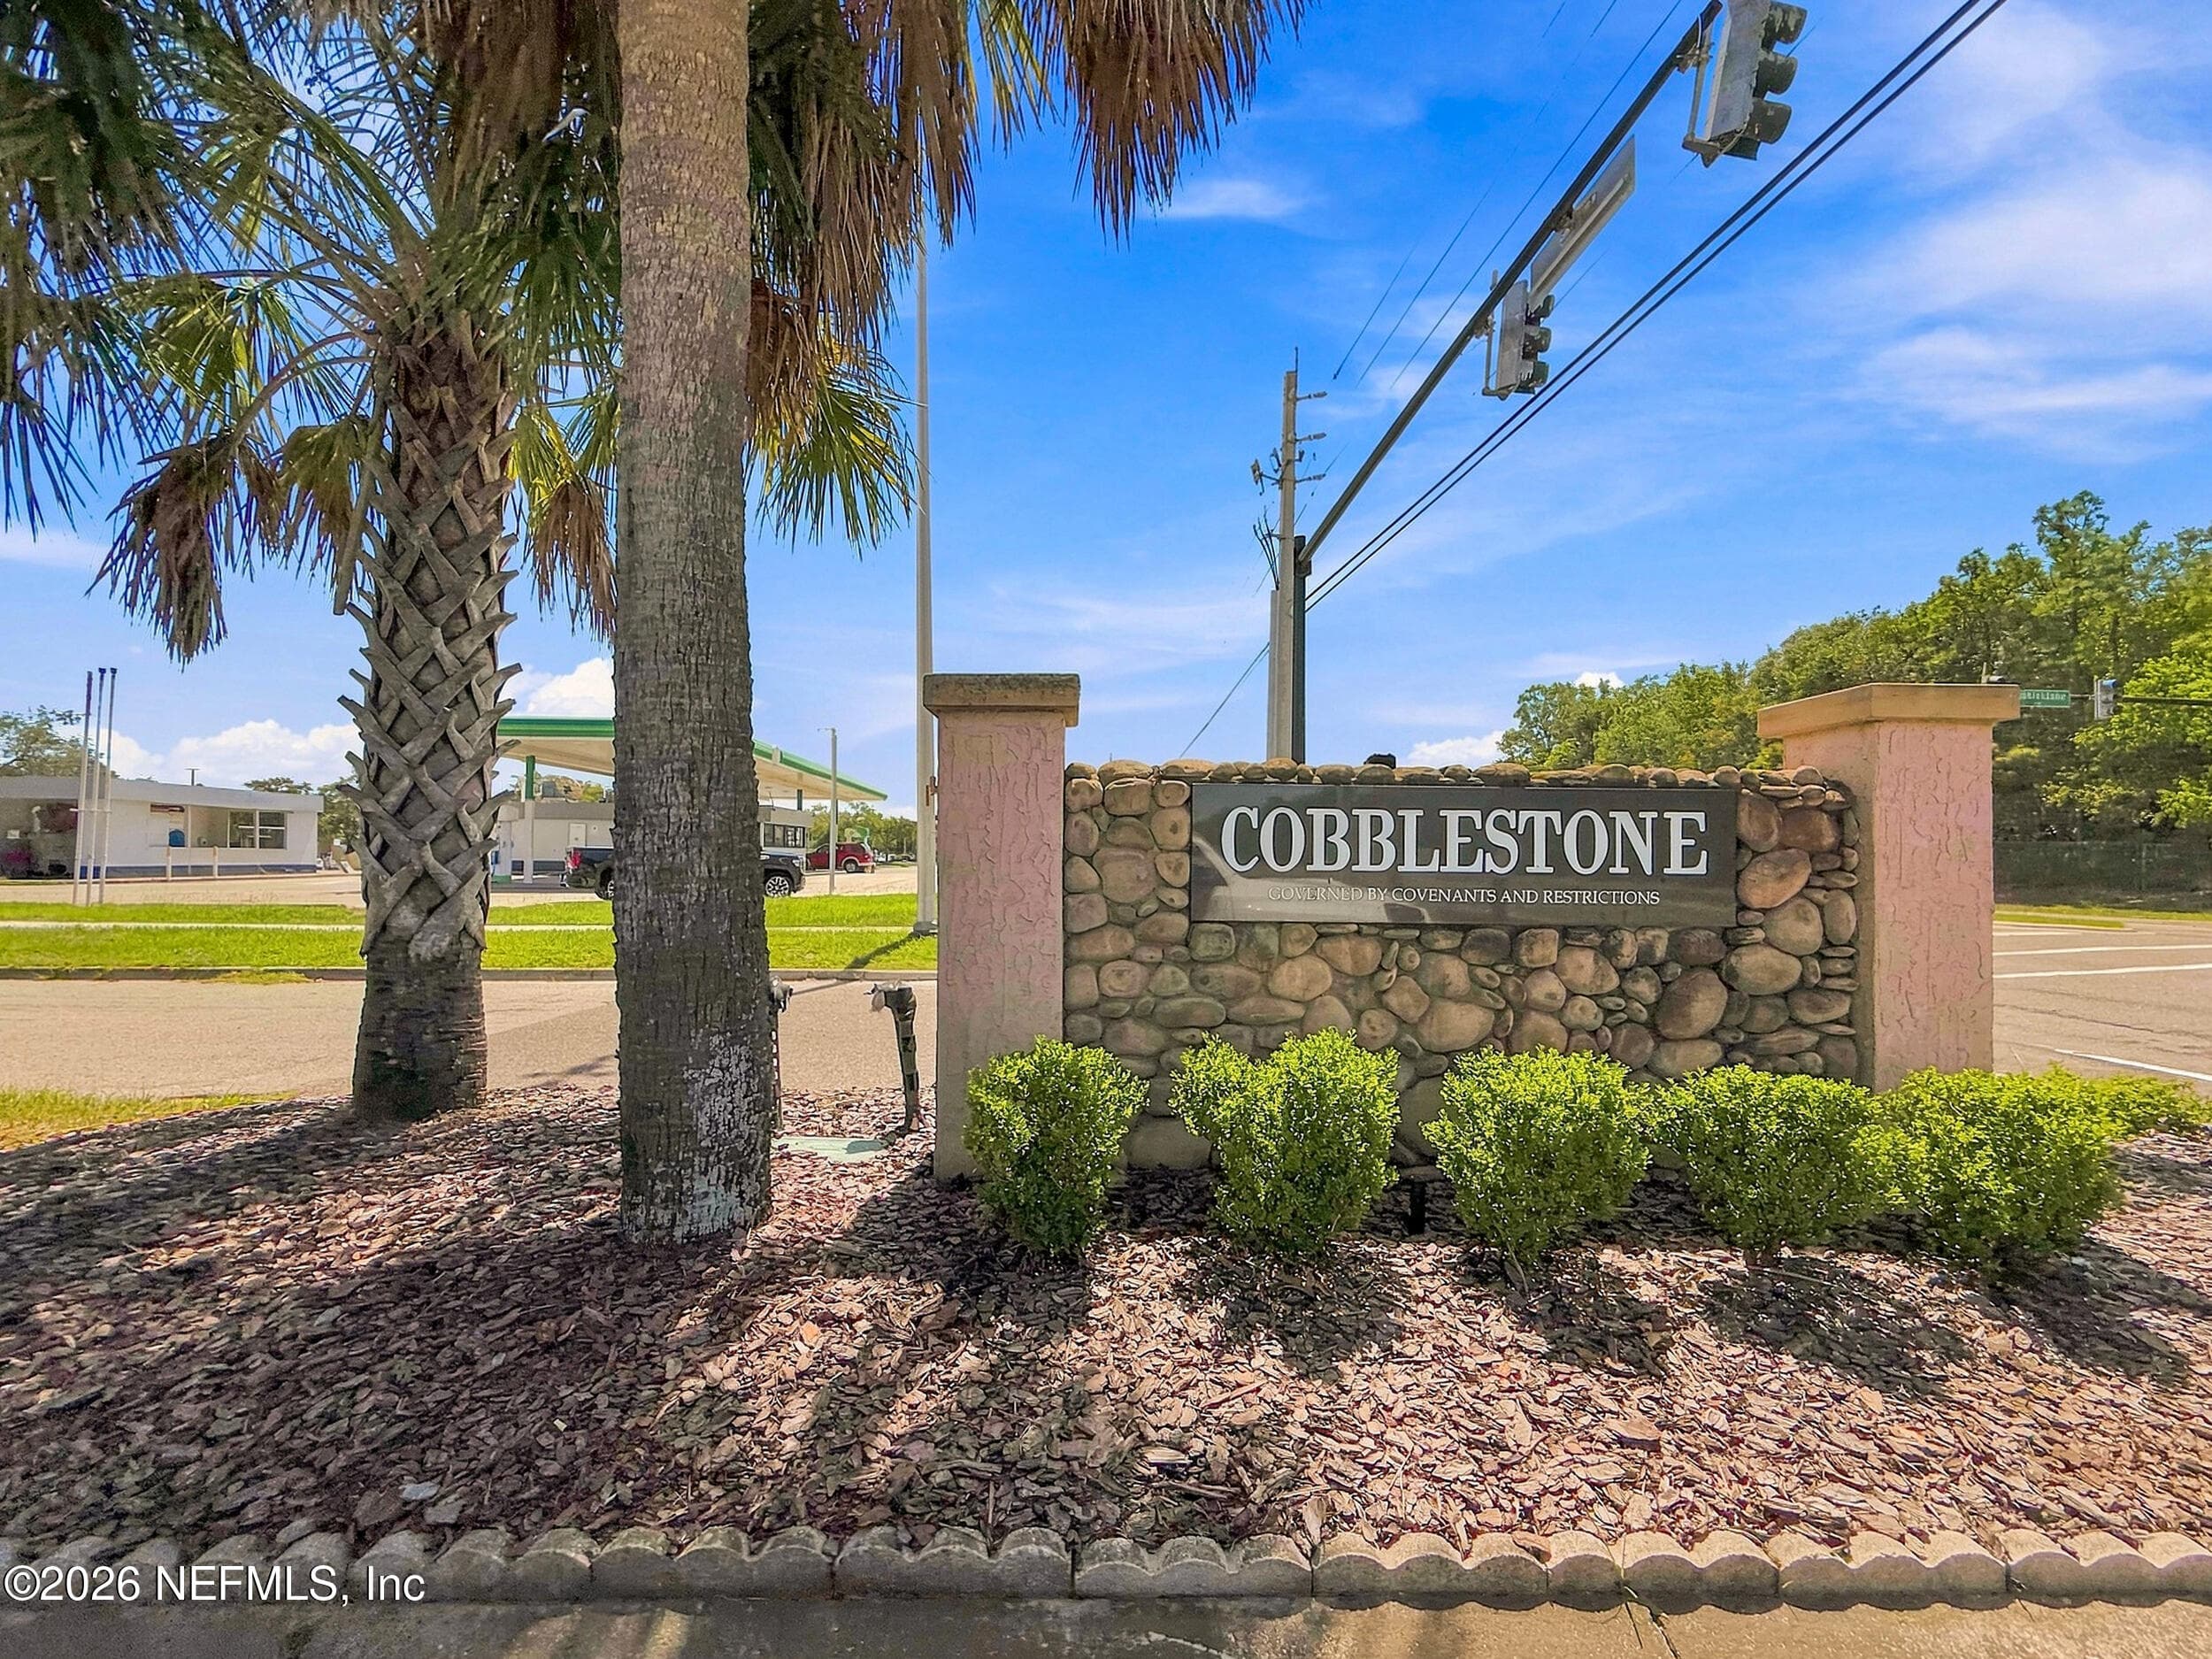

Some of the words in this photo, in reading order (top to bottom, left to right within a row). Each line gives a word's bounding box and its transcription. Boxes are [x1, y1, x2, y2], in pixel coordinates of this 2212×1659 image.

[1220, 805, 1708, 876] COBBLESTONE
[1268, 886, 1363, 902] GOVERNED
[1368, 887, 1388, 902] BY
[1391, 887, 1497, 903] COVENANTS
[1501, 889, 1539, 903] AND
[1543, 890, 1660, 905] RESTRICTIONS
